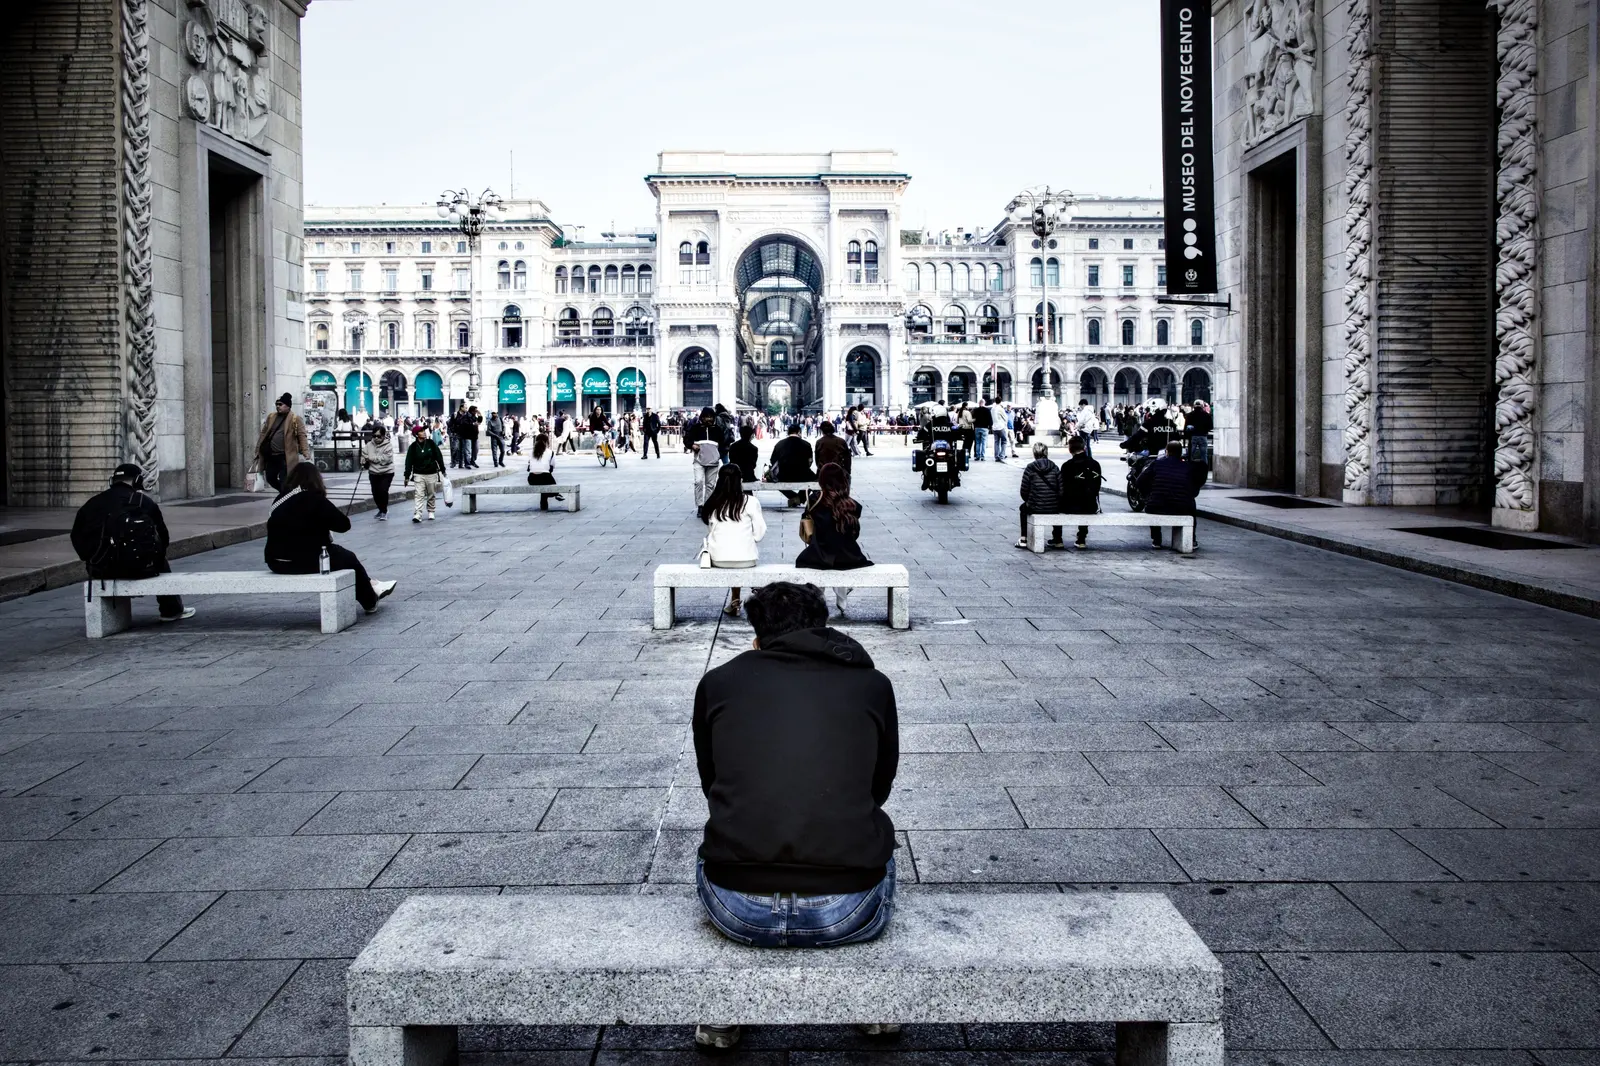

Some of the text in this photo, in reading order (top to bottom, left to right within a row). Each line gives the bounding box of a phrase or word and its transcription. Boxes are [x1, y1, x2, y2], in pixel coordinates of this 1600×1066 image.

[1179, 7, 1194, 113] NOVECENTO
[1180, 117, 1194, 148] DEL
[1181, 152, 1196, 212] MUSEO
